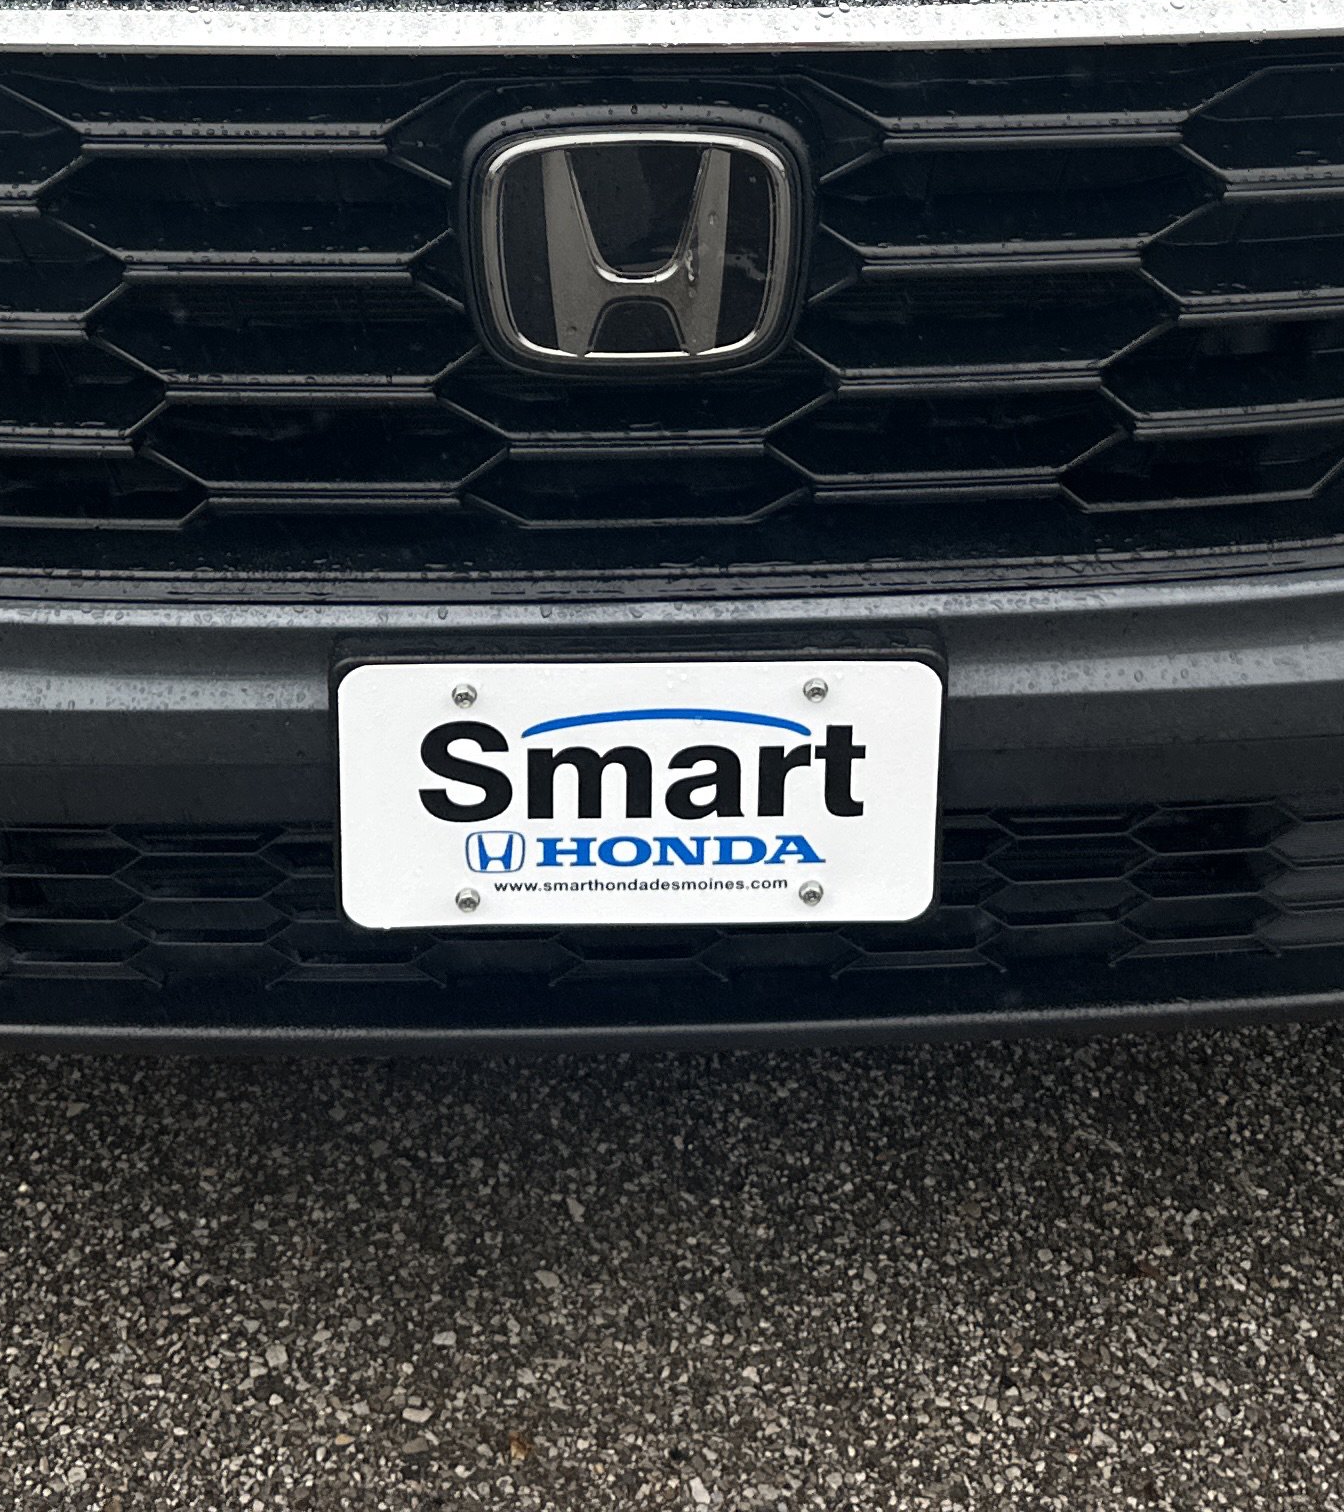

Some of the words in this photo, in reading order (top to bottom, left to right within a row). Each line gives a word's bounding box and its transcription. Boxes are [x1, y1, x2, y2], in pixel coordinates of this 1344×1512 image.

[418, 720, 867, 823] Smart
[536, 834, 826, 867] HONDA
[493, 877, 789, 893] www.smarthondadesmoines.com
